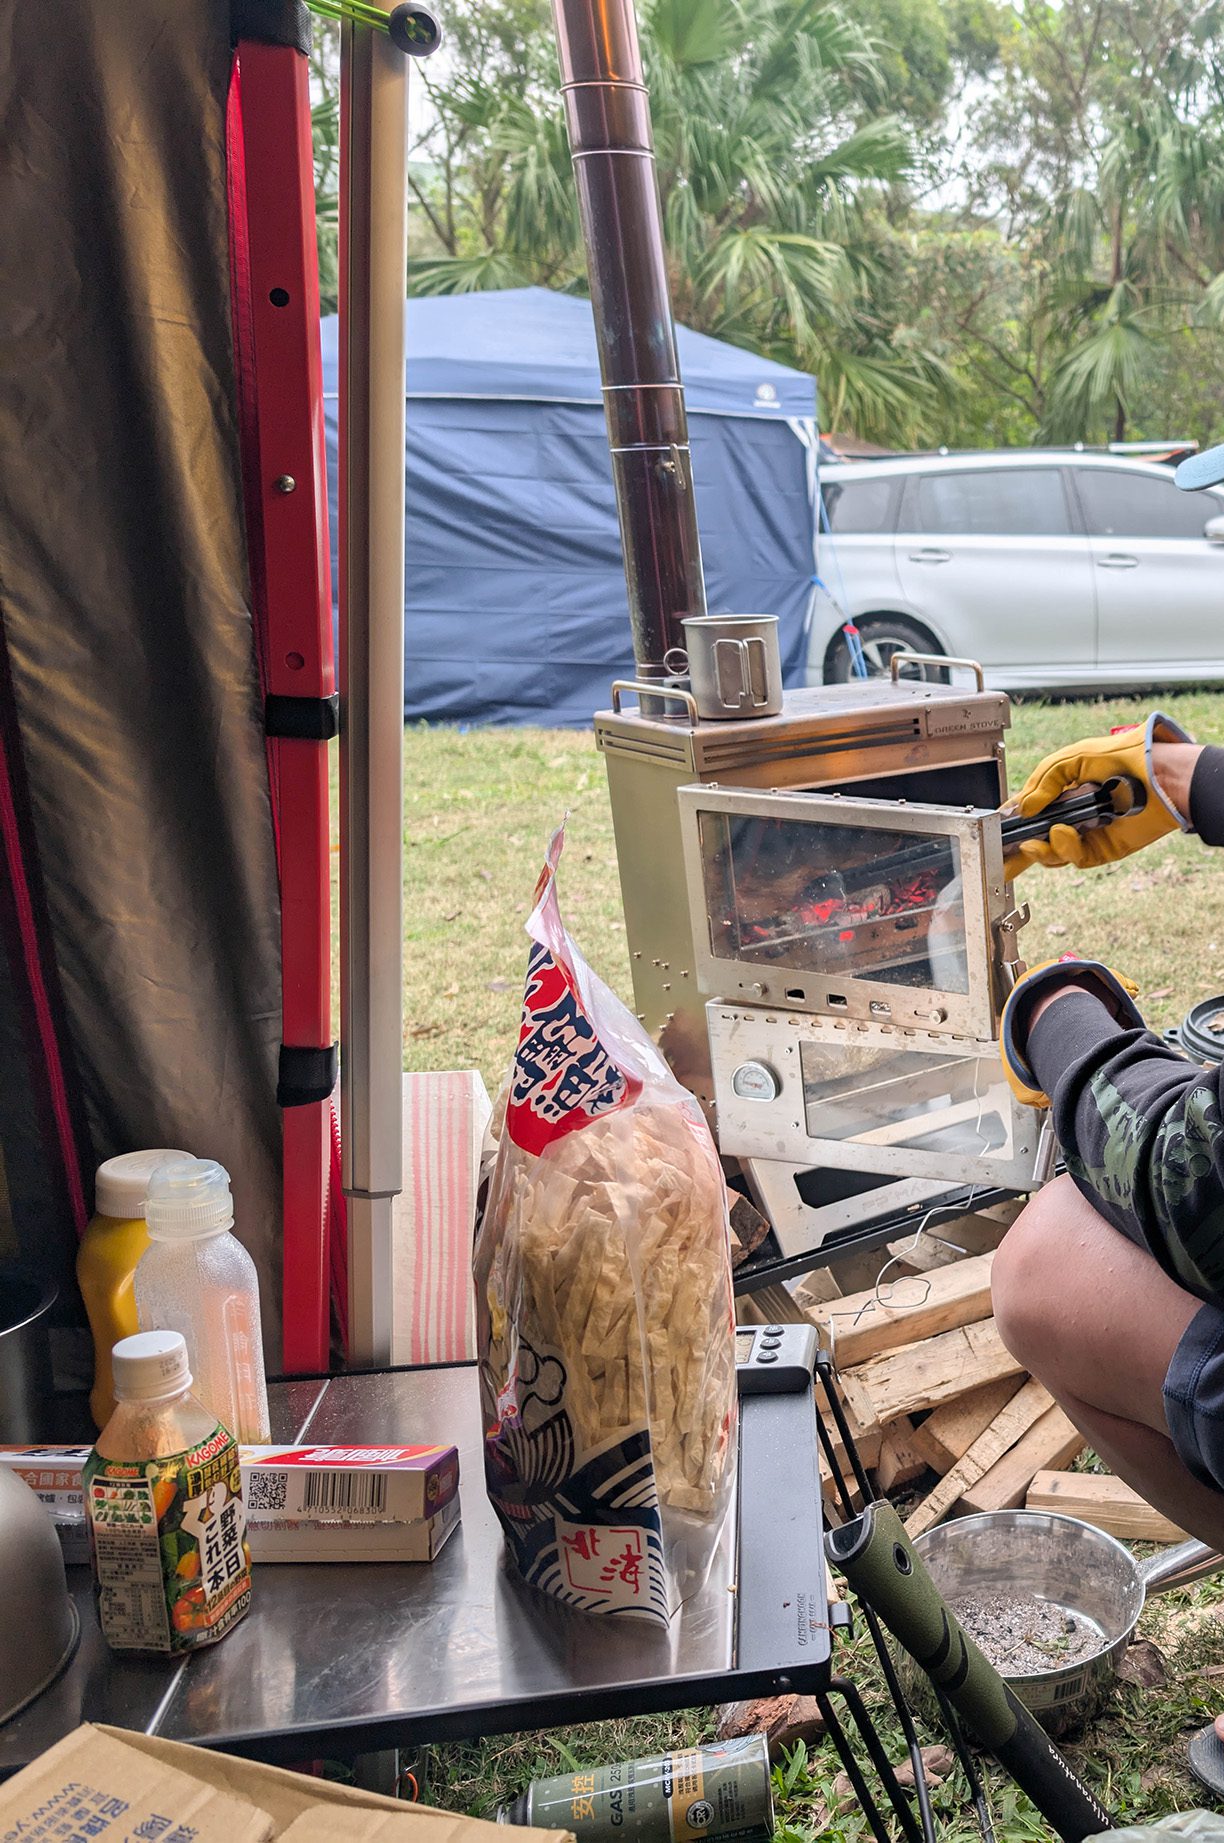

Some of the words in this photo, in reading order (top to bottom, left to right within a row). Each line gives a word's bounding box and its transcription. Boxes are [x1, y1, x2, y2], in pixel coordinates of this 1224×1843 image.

[969, 720, 999, 730] STOVE
[185, 1431, 230, 1469] KAGOME
[205, 1520, 226, 1594] これ一本
[220, 1503, 242, 1580] 野菜一日
[571, 1773, 595, 1821] 安控
[611, 1789, 623, 1827] GAS
